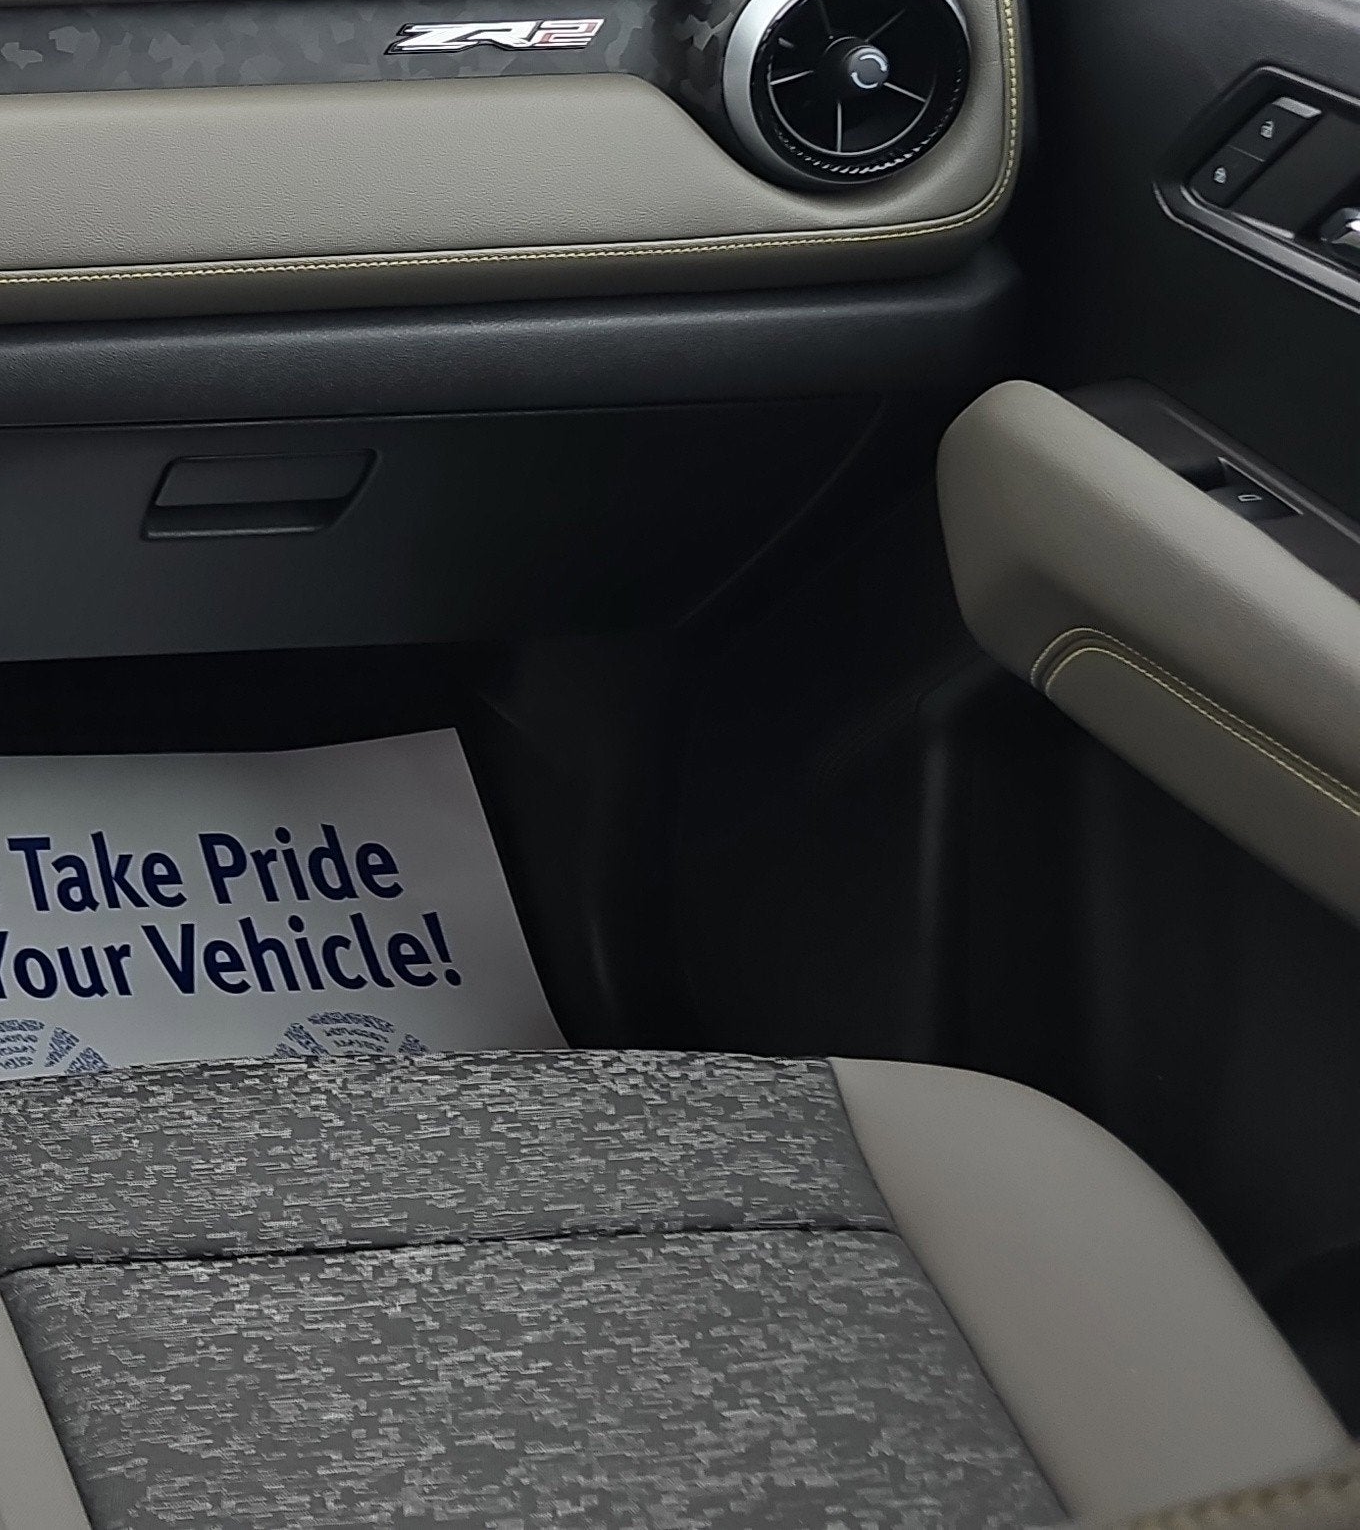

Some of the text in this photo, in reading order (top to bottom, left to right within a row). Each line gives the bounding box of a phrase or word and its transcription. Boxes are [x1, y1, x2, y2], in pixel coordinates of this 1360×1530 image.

[384, 18, 605, 55] ZR2
[7, 831, 188, 912] Take
[198, 824, 403, 905] Pride
[142, 912, 462, 996] Vehicle!
